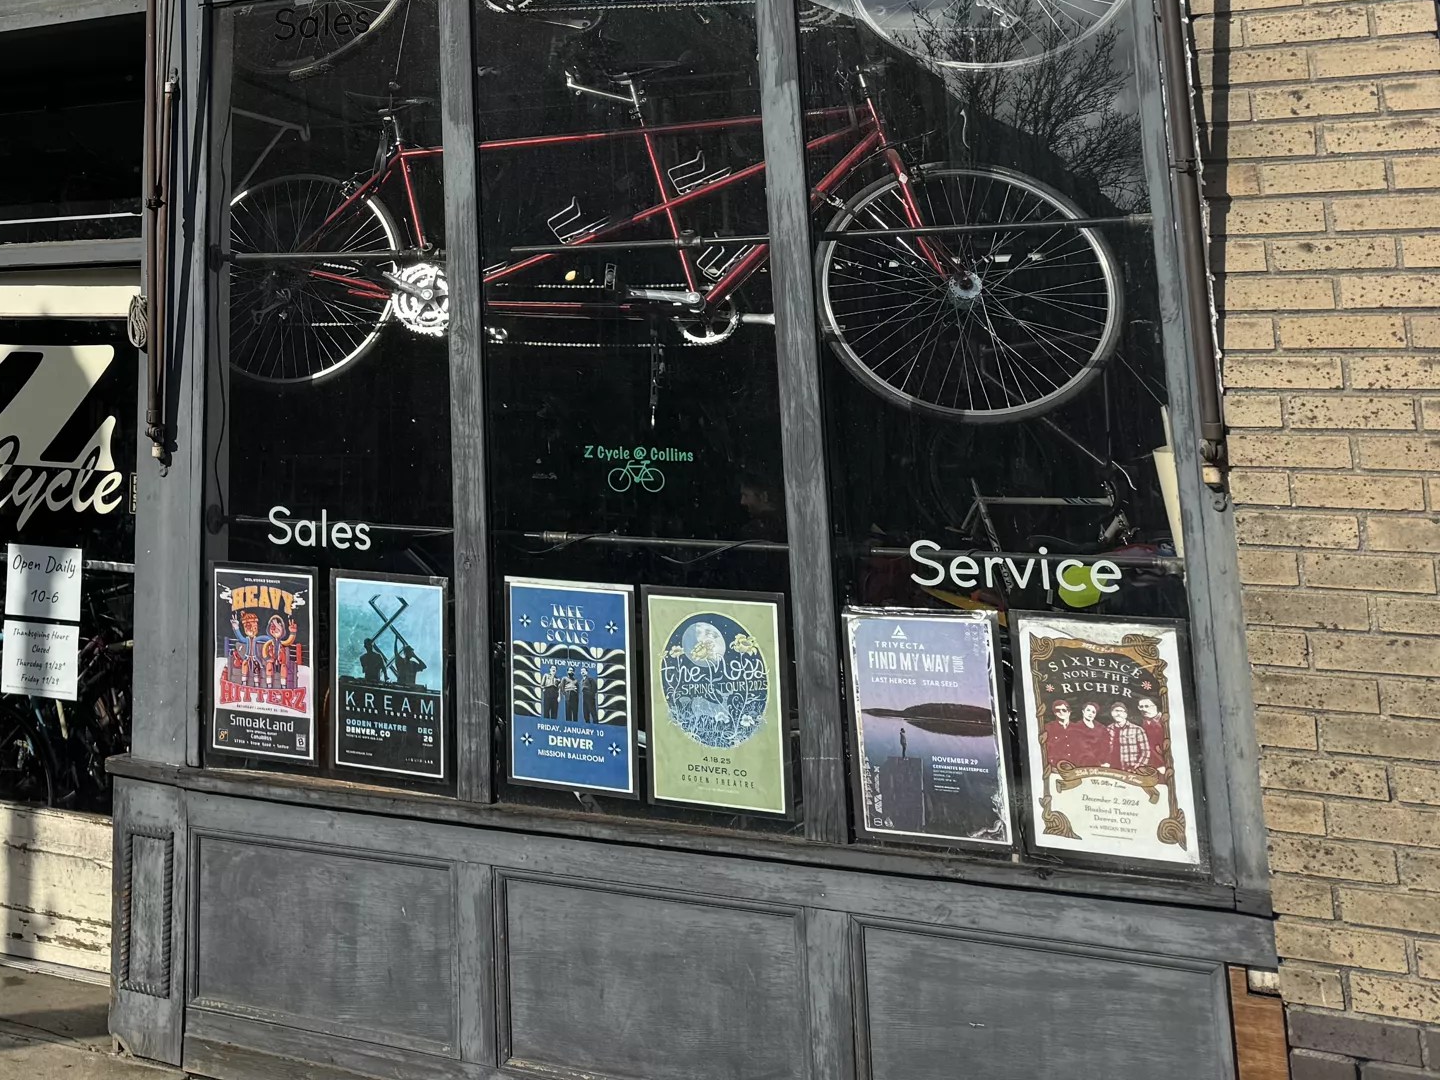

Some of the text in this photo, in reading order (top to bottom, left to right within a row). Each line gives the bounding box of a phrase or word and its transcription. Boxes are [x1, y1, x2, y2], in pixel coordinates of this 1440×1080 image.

[274, 3, 371, 41] Sales
[584, 446, 694, 463] Z Cycle @ Collins
[267, 505, 372, 551] Sales
[12, 554, 76, 578] Open Daily
[909, 539, 1123, 594] Service
[30, 589, 60, 604] 10-6
[231, 585, 295, 615] HEAVY
[540, 615, 595, 632] SACRED
[13, 628, 69, 641] Thanksgiving Hours
[546, 629, 589, 645] SOULS
[32, 644, 51, 654] Closed
[874, 640, 925, 650] TRIVECTA
[16, 659, 43, 670] Thursday
[581, 661, 596, 669] TOUR
[868, 650, 950, 673] FIND MY WAY
[1048, 656, 1143, 679] SIXPENCE
[660, 655, 769, 683] the Moss
[20, 674, 60, 686] Friday 11/29
[888, 677, 916, 685] HEROES
[1063, 670, 1129, 684] NONE THE
[681, 679, 768, 695] SPRING TOUR 2025
[1061, 681, 1133, 698] RICHER
[220, 679, 306, 713] HITTERZ
[345, 691, 434, 715] KREAM
[346, 706, 378, 714] WINTER
[384, 710, 407, 718] TOUR
[346, 726, 391, 738] DENVER, CO
[373, 721, 407, 731] THEATRE
[417, 727, 433, 735] DEC
[563, 726, 594, 736] JANUARY
[596, 729, 604, 737] 10
[423, 735, 433, 743] 20
[548, 734, 593, 750] DENVER
[537, 749, 605, 763] MISSION BALLROOM
[703, 755, 731, 764] 4.18.25
[932, 755, 979, 766] NOVEMBER 29
[687, 764, 747, 777] DENVER, CO
[681, 774, 755, 789] OGDEN THEATRE
[1082, 793, 1111, 803] December
[1122, 798, 1140, 806] 2024
[1084, 804, 1139, 816] Bluebird Theater
